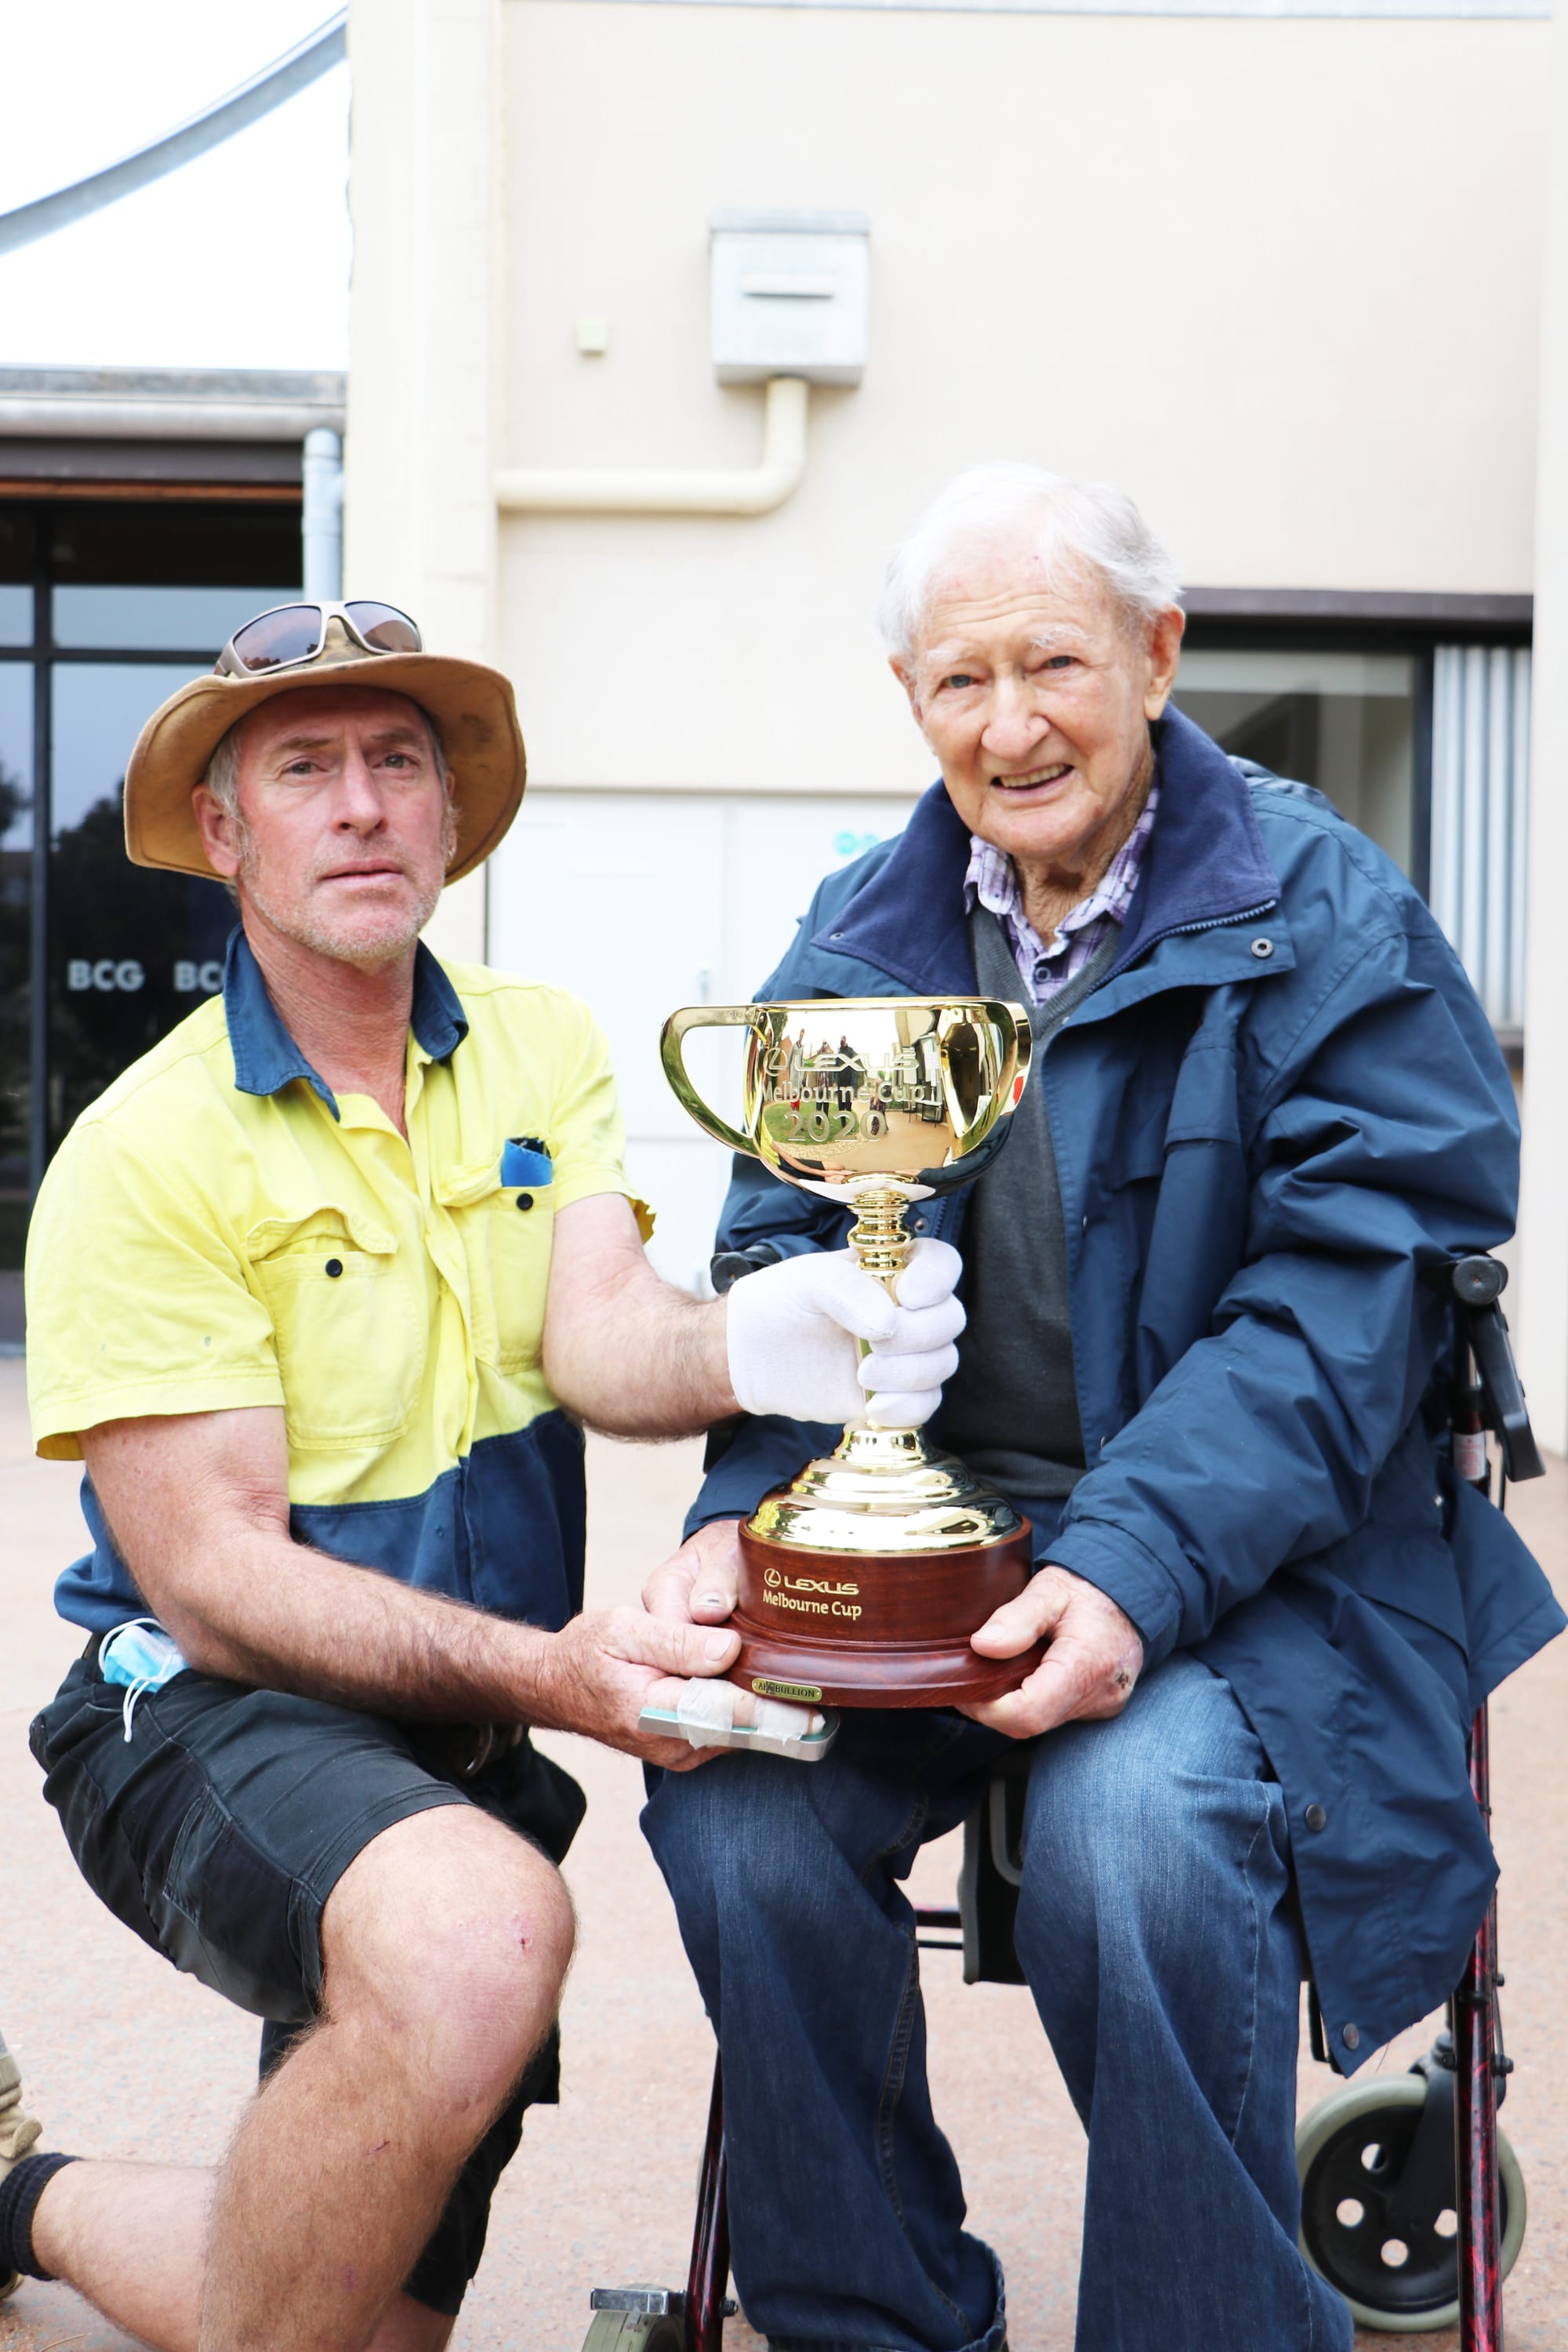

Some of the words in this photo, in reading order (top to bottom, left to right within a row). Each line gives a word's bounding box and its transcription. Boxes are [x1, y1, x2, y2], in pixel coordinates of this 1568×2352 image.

[68, 960, 144, 991] BCG
[174, 961, 226, 992] BC
[794, 1051, 919, 1073] LEXUS
[761, 1081, 874, 1103] Melbourne
[877, 1080, 925, 1105] Cup
[784, 1110, 886, 1142] 2020
[784, 1575, 859, 1595] LEXUS
[763, 1589, 829, 1615] Melbourne
[831, 1601, 862, 1621] Cup
[775, 1685, 815, 1697] BULLION
